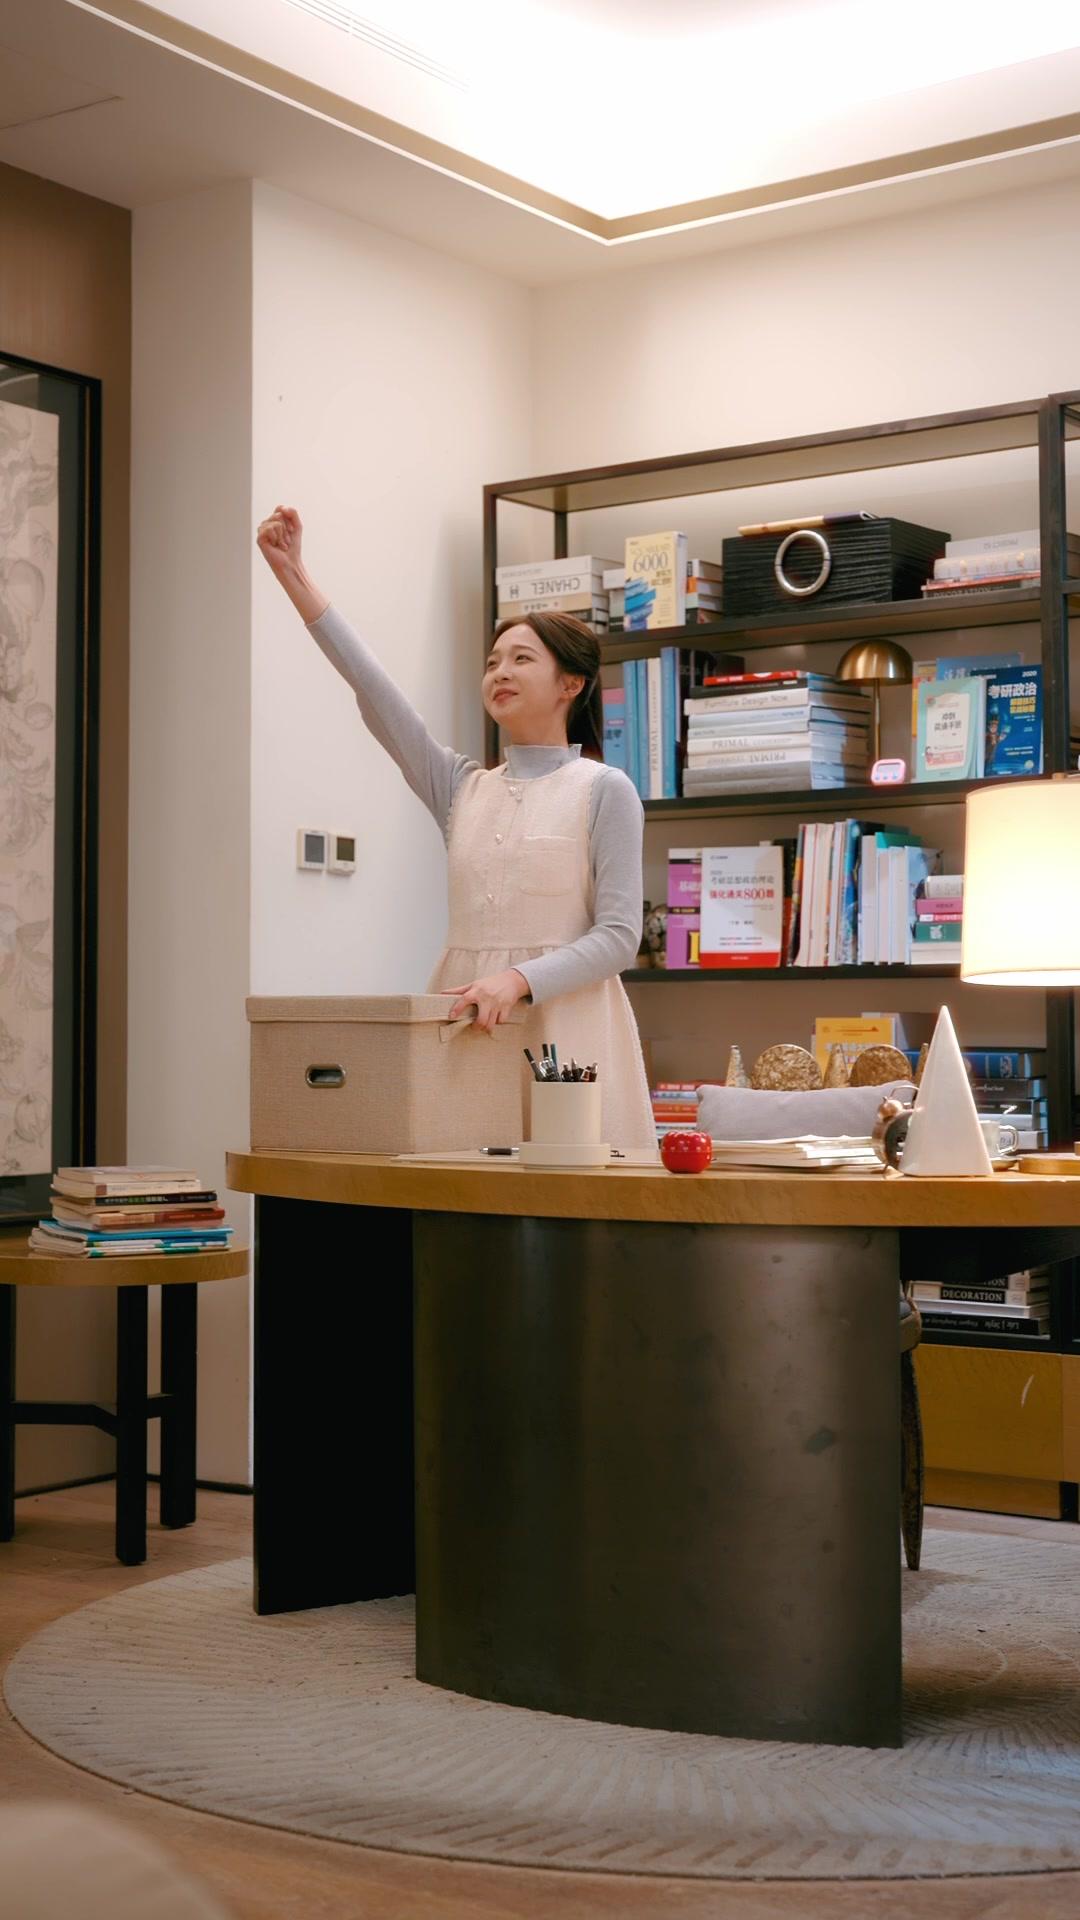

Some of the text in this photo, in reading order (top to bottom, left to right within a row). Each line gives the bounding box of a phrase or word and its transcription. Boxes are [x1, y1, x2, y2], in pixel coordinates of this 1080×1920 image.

[633, 551, 669, 573] 6000
[530, 577, 581, 594] CHANEL
[987, 682, 1038, 699] 考研政治
[741, 696, 769, 706] Design
[771, 694, 788, 703] Now
[711, 738, 750, 749] PRIMAL
[749, 752, 786, 763] PRIMAL
[942, 1289, 1003, 1302] DECORATION
